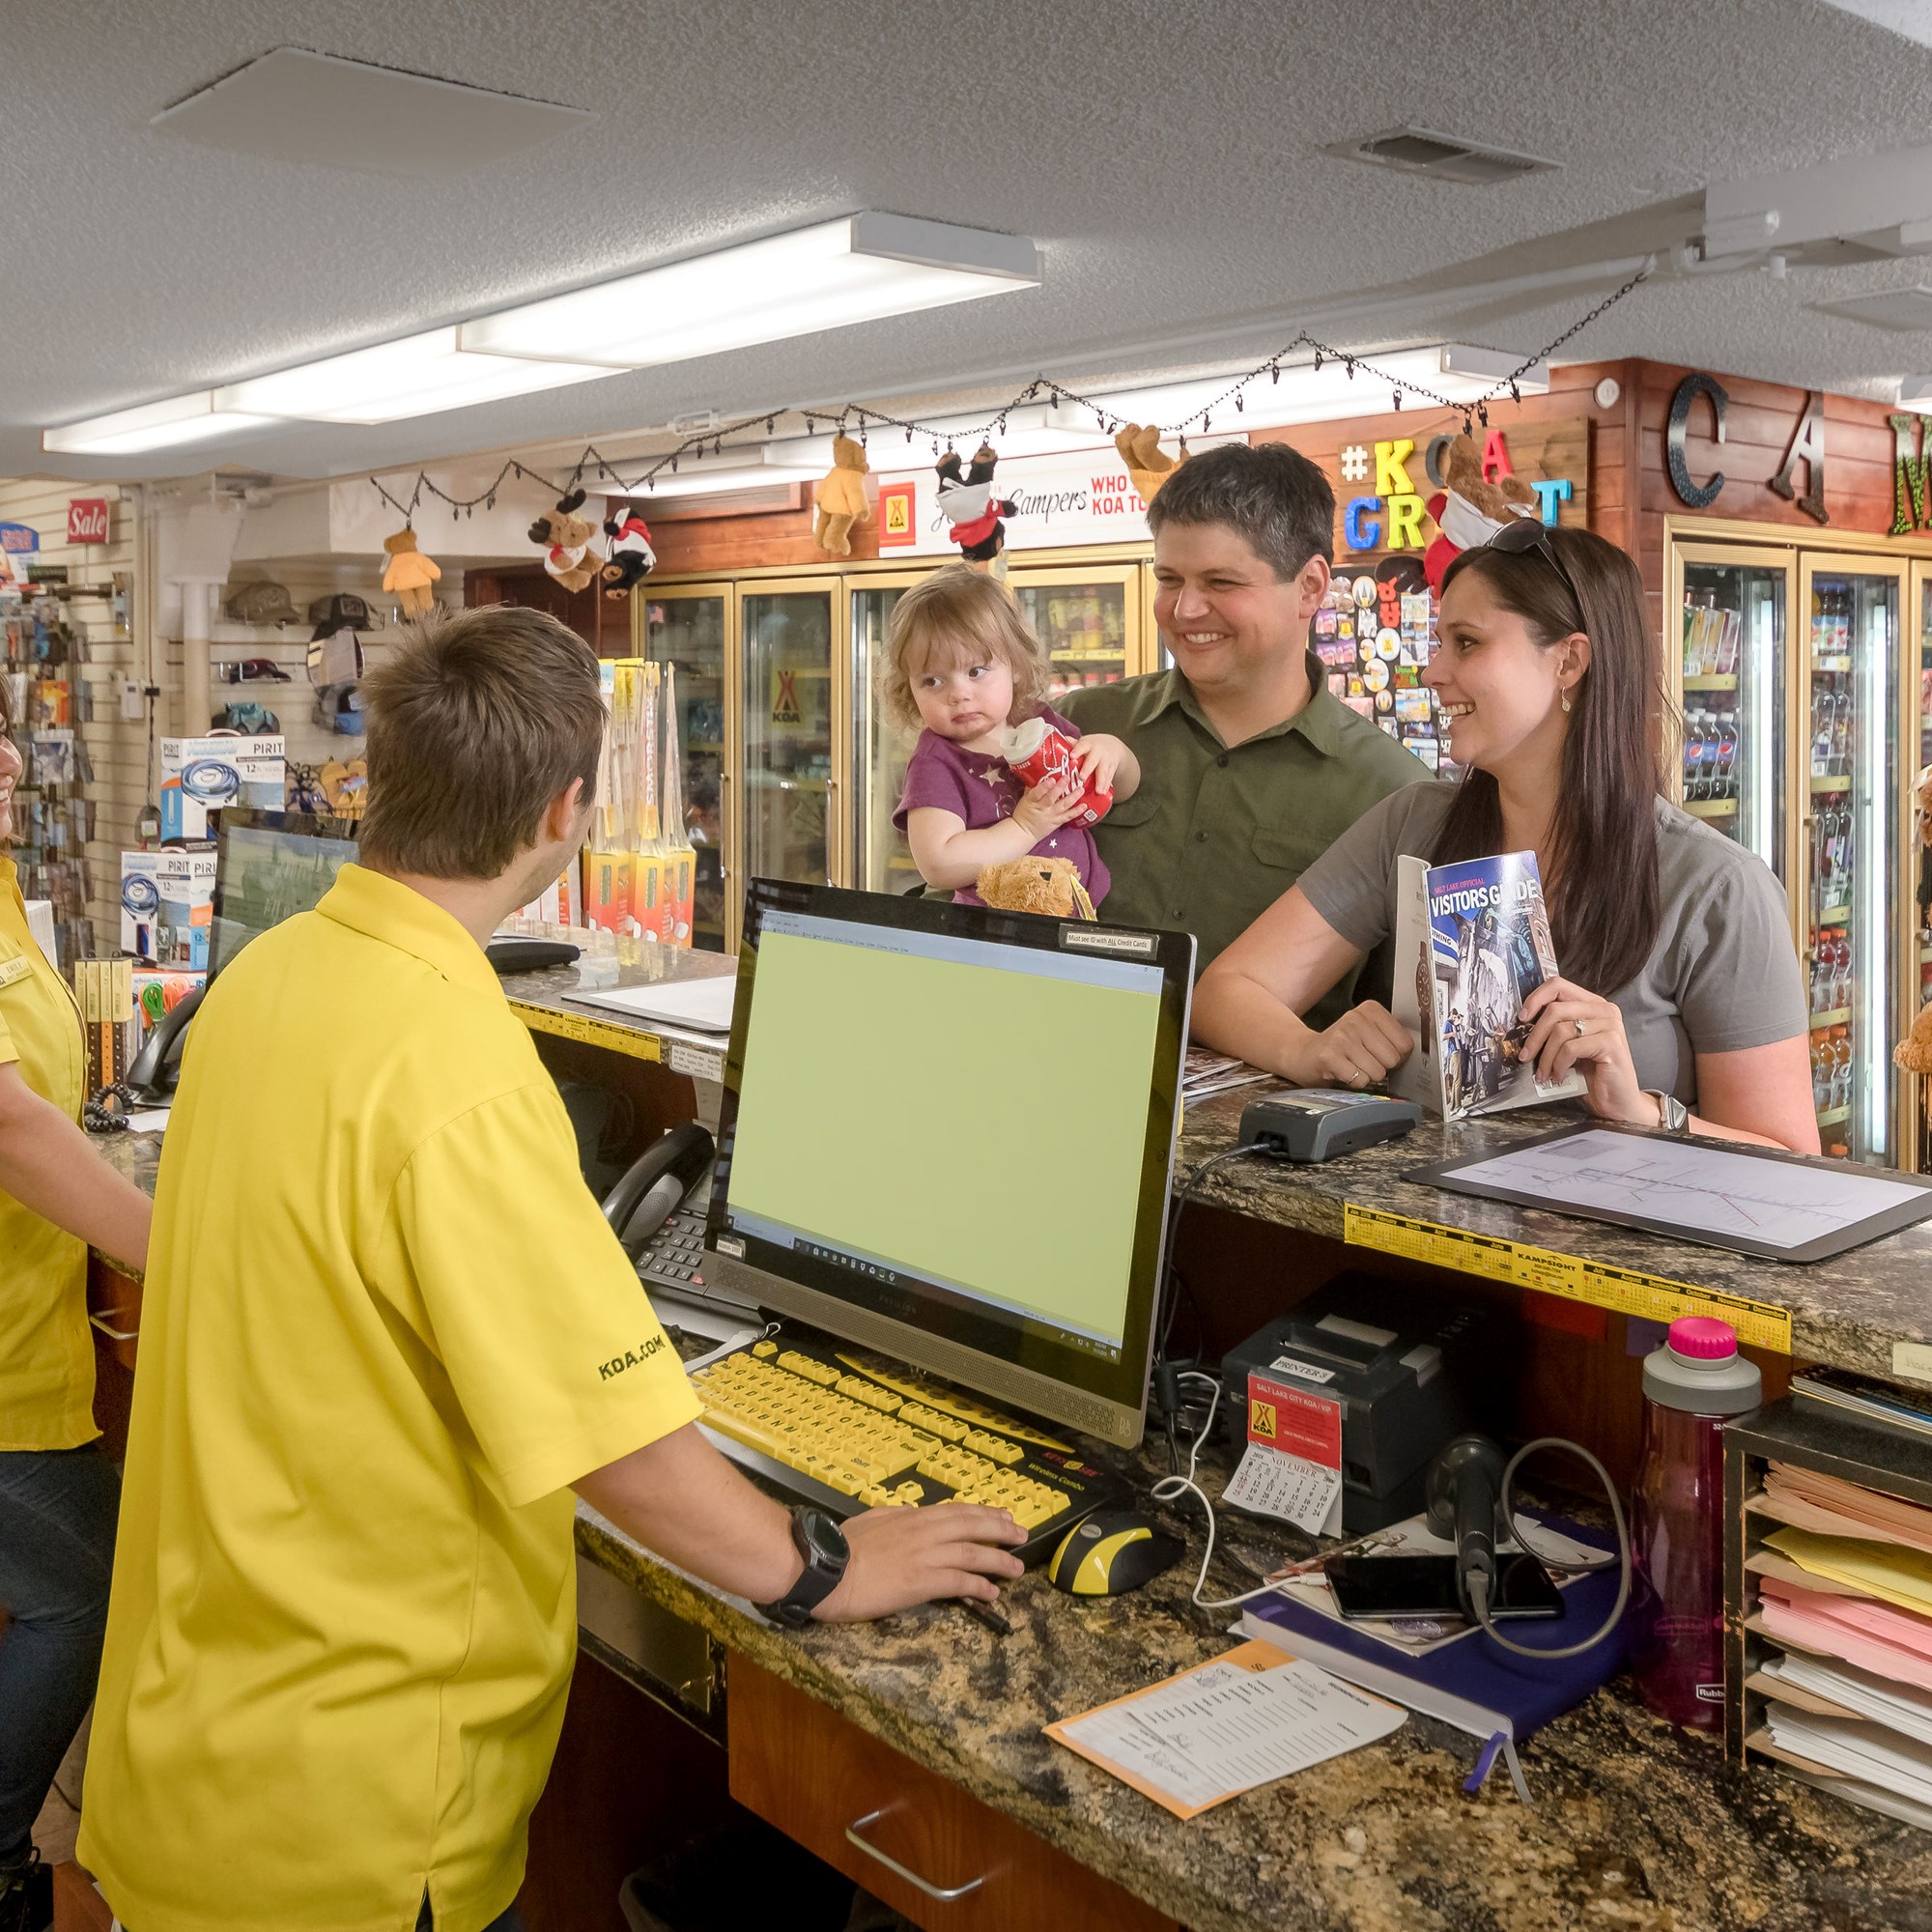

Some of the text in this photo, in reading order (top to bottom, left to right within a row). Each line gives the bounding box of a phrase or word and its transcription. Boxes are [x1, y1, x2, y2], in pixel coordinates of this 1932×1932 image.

[1091, 475, 1126, 495] WHO
[1093, 497, 1124, 516] KOA
[71, 507, 107, 537] Sale
[773, 712, 801, 723] KOA
[253, 743, 283, 754] PIRIT
[246, 764, 256, 773] 12
[168, 861, 190, 872] PIRIT
[1431, 887, 1489, 918] VISITORS
[1107, 938, 1117, 947] ALL
[1132, 940, 1148, 949] Cards
[1376, 1214, 1398, 1225] February
[1406, 1222, 1421, 1231] March
[1518, 1253, 1577, 1272] KAMPSIGHT
[1593, 1267, 1605, 1276] July
[1620, 1273, 1642, 1284] August
[1648, 1280, 1681, 1293] September
[1686, 1289, 1711, 1300] October
[1717, 1296, 1749, 1310] November
[1752, 1305, 1786, 1319] December
[598, 1334, 666, 1381] KOA.COM
[1276, 1360, 1320, 1377] PRINTER
[1257, 1383, 1270, 1393] SALT
[1272, 1388, 1288, 1399] LAKE
[1289, 1394, 1302, 1404] CITY
[1304, 1399, 1318, 1409] KOA
[1253, 1425, 1274, 1436] KOA
[1270, 1456, 1317, 1478] NOVEMBER
[1029, 1463, 1085, 1492] Wireless Combo
[1699, 1689, 1724, 1698] Rubb
